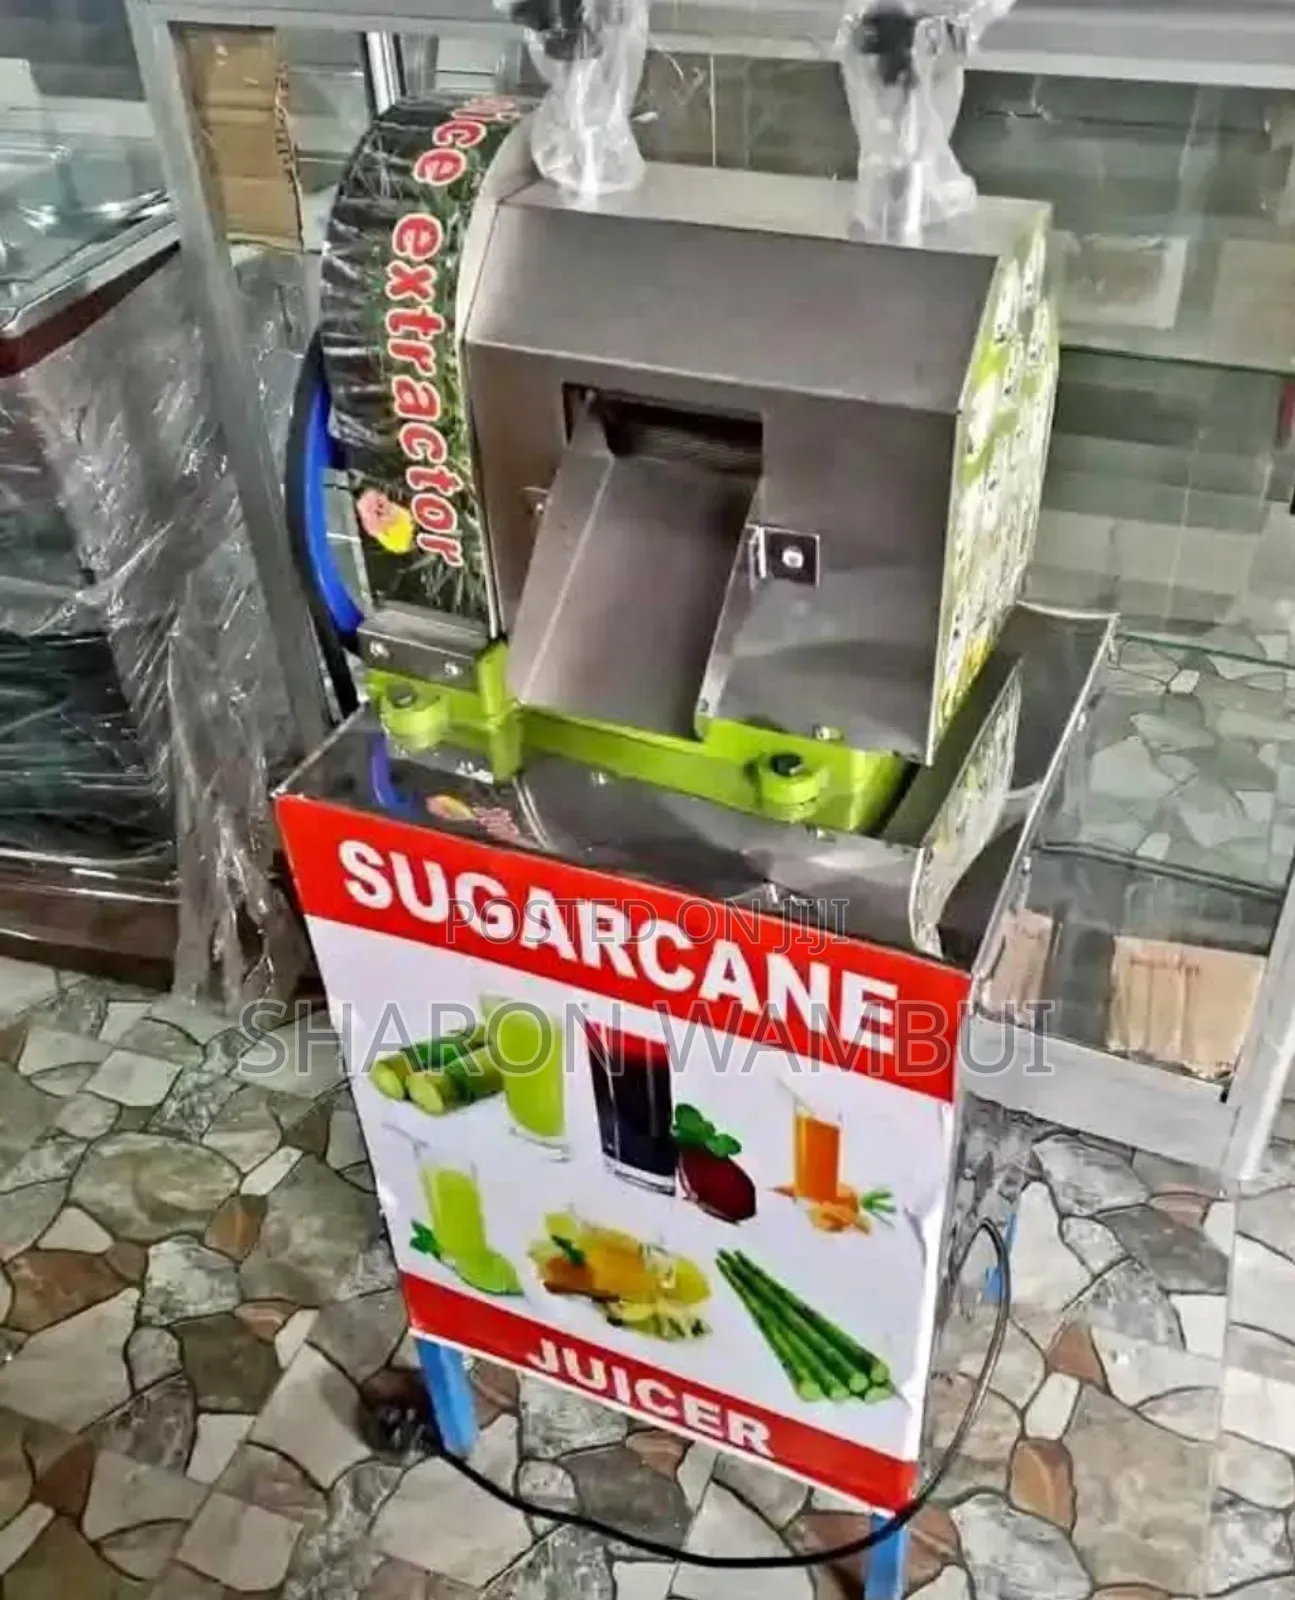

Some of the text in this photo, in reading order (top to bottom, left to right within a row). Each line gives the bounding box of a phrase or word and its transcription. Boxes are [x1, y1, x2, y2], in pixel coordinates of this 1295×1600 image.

[385, 212, 464, 568] extractor
[337, 839, 898, 1055] SUGARCANE
[527, 1339, 774, 1457] JUICER
